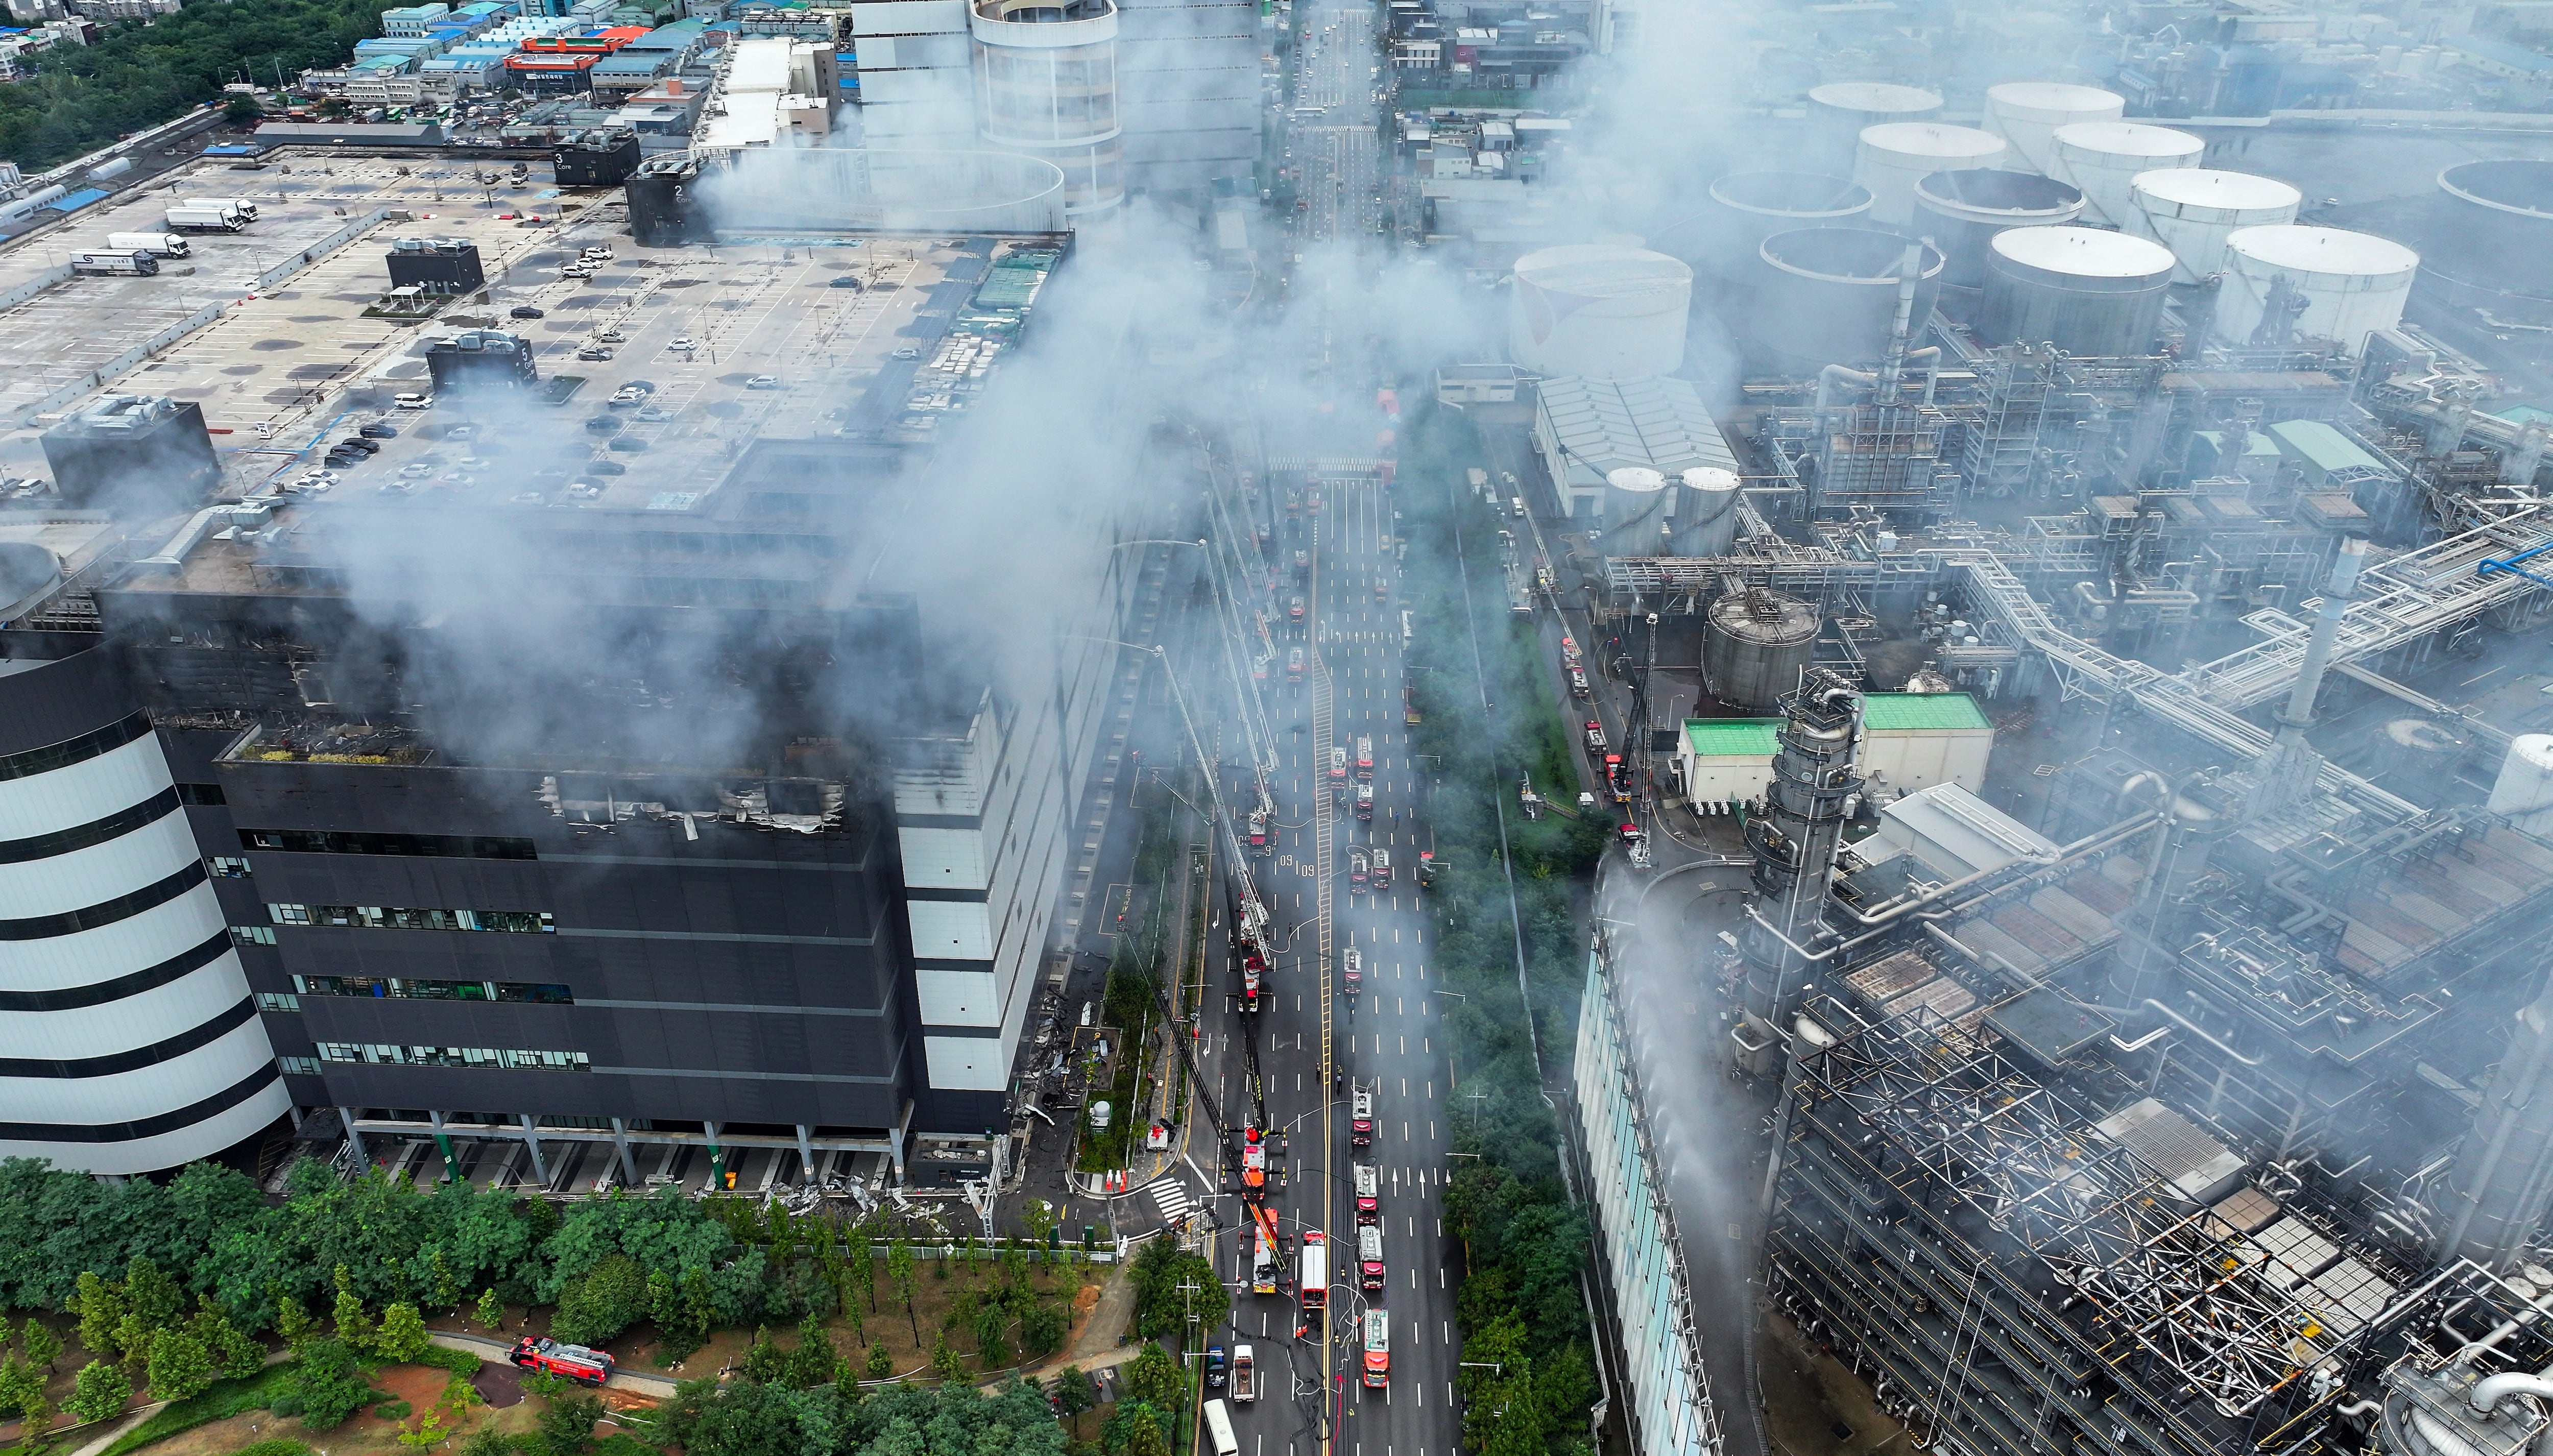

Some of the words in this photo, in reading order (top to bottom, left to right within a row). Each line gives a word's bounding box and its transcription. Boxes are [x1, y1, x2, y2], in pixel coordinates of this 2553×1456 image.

[555, 153, 563, 163] 3
[675, 185, 683, 197] 2
[522, 348, 528, 361] 5
[524, 359, 534, 370] Core
[1280, 855, 1292, 866] 60
[1302, 865, 1314, 877] 60
